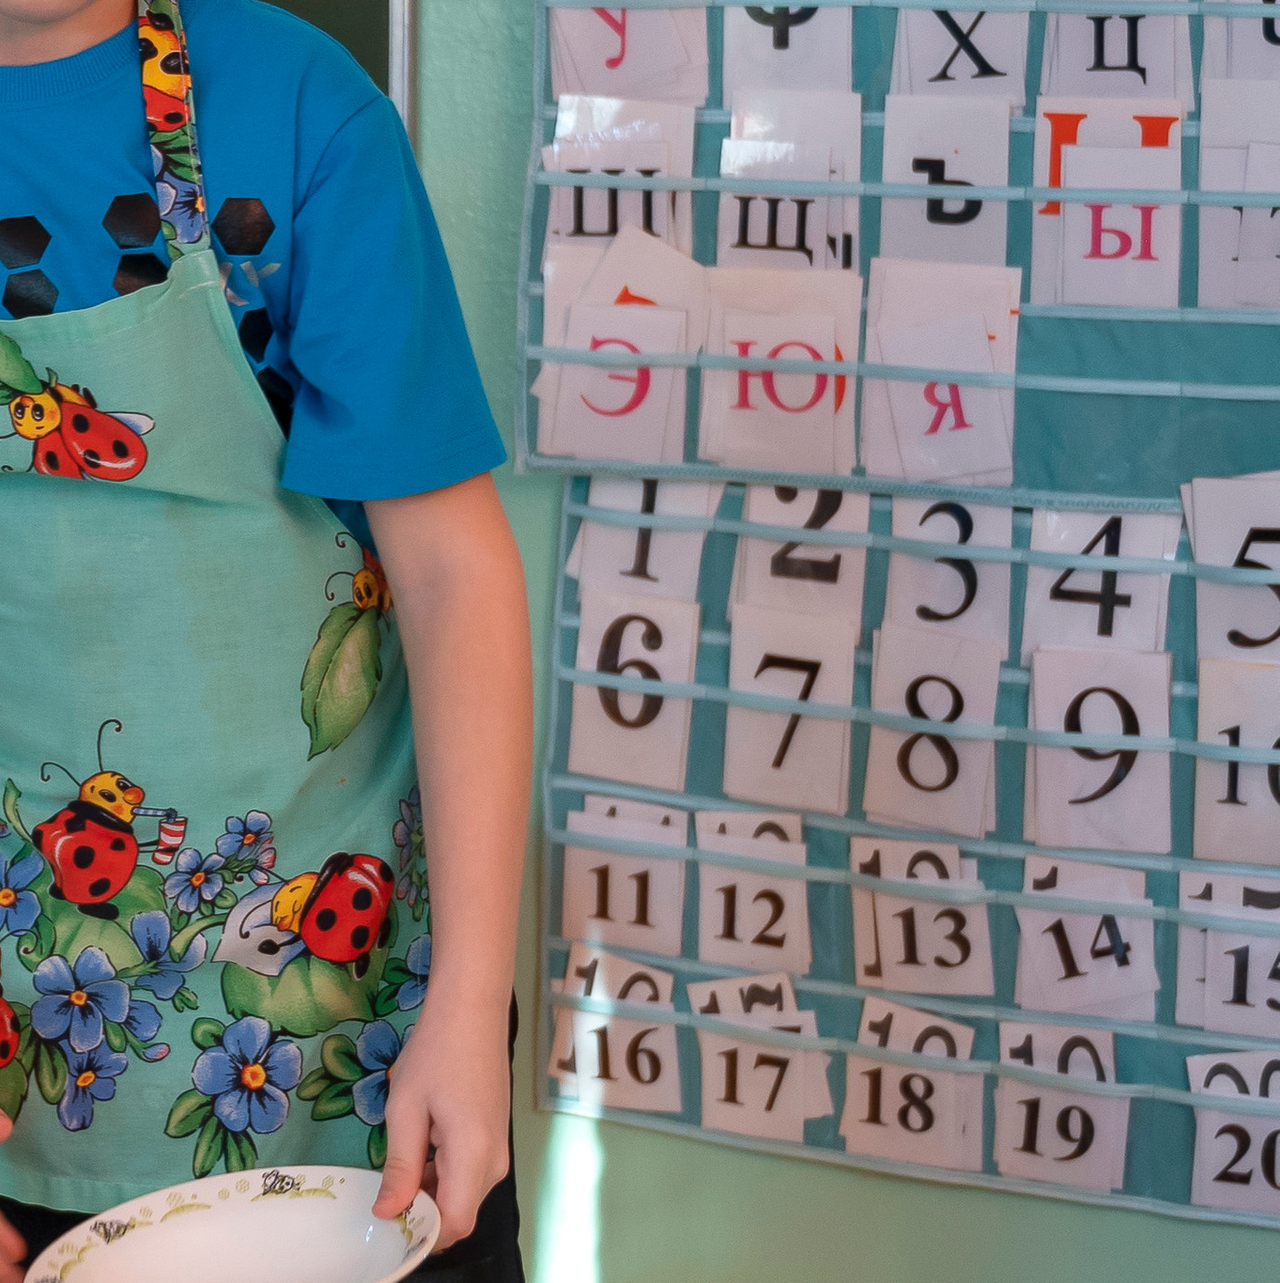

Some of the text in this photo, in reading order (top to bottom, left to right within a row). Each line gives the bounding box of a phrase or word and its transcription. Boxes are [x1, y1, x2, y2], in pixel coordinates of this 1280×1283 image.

[915, 500, 979, 622] 3
[1049, 516, 1132, 637] 4
[596, 613, 664, 730] 6
[754, 653, 821, 769] 7
[896, 674, 965, 793] 8
[1063, 686, 1142, 805] 9
[587, 863, 656, 929] 11
[716, 883, 788, 948] 12
[891, 908, 973, 970] 13
[1041, 914, 1132, 983] 14
[588, 1026, 662, 1086] 16
[716, 1046, 790, 1113] 17
[859, 1066, 936, 1134] 18
[1015, 1098, 1096, 1163] 19
